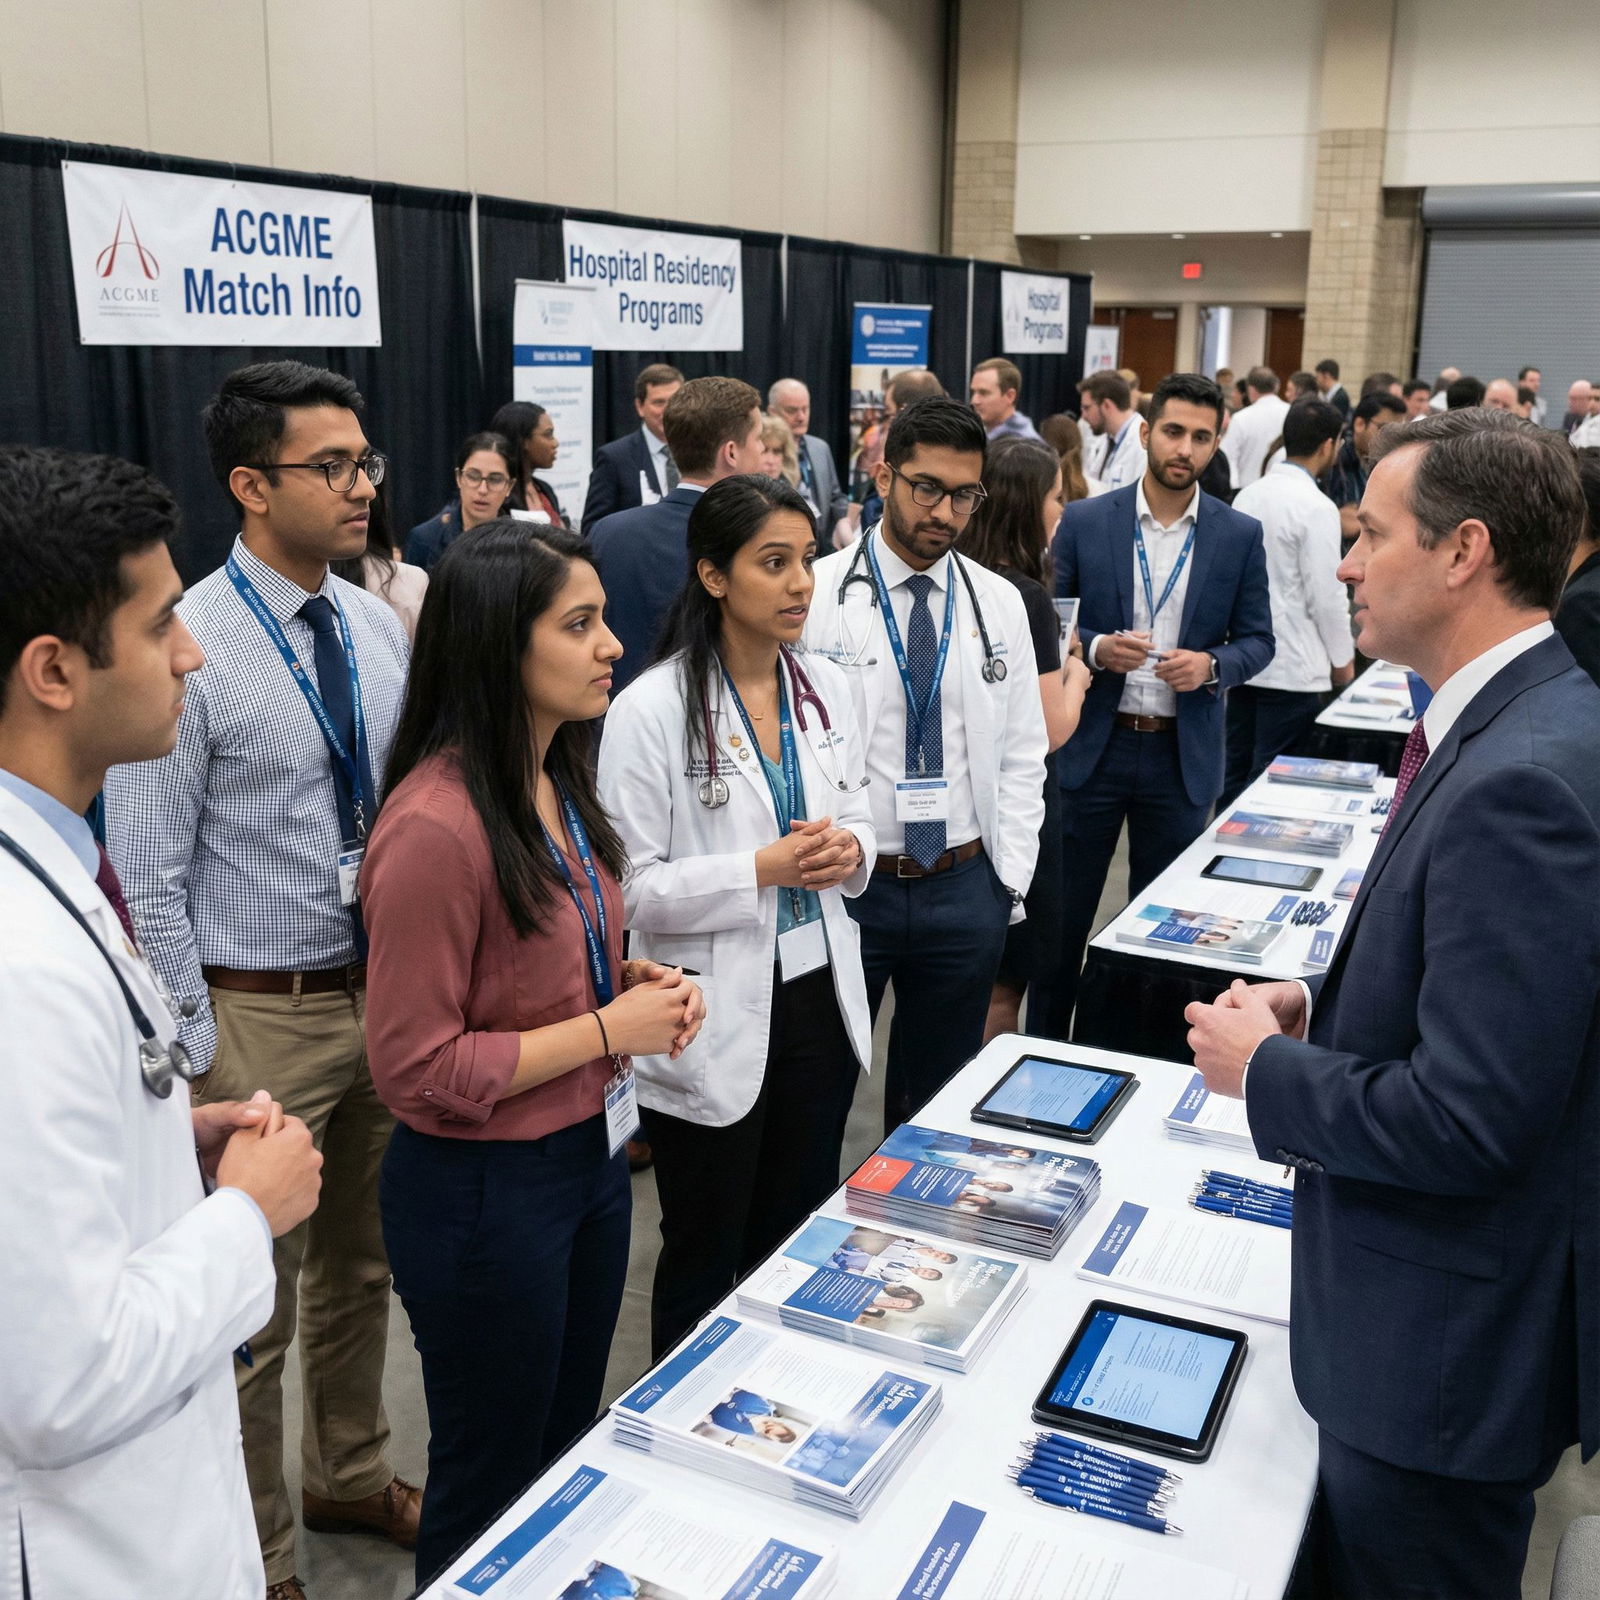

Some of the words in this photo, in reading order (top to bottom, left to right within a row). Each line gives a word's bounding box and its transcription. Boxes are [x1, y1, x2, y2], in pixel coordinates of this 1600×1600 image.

[210, 207, 333, 259] ACGME
[569, 245, 647, 287] Hospital
[654, 253, 736, 293] Residency
[100, 286, 160, 302] ACGME
[183, 268, 292, 316] Match
[303, 274, 362, 318] Info
[619, 292, 703, 331] Programs
[1027, 287, 1061, 315] Hospital
